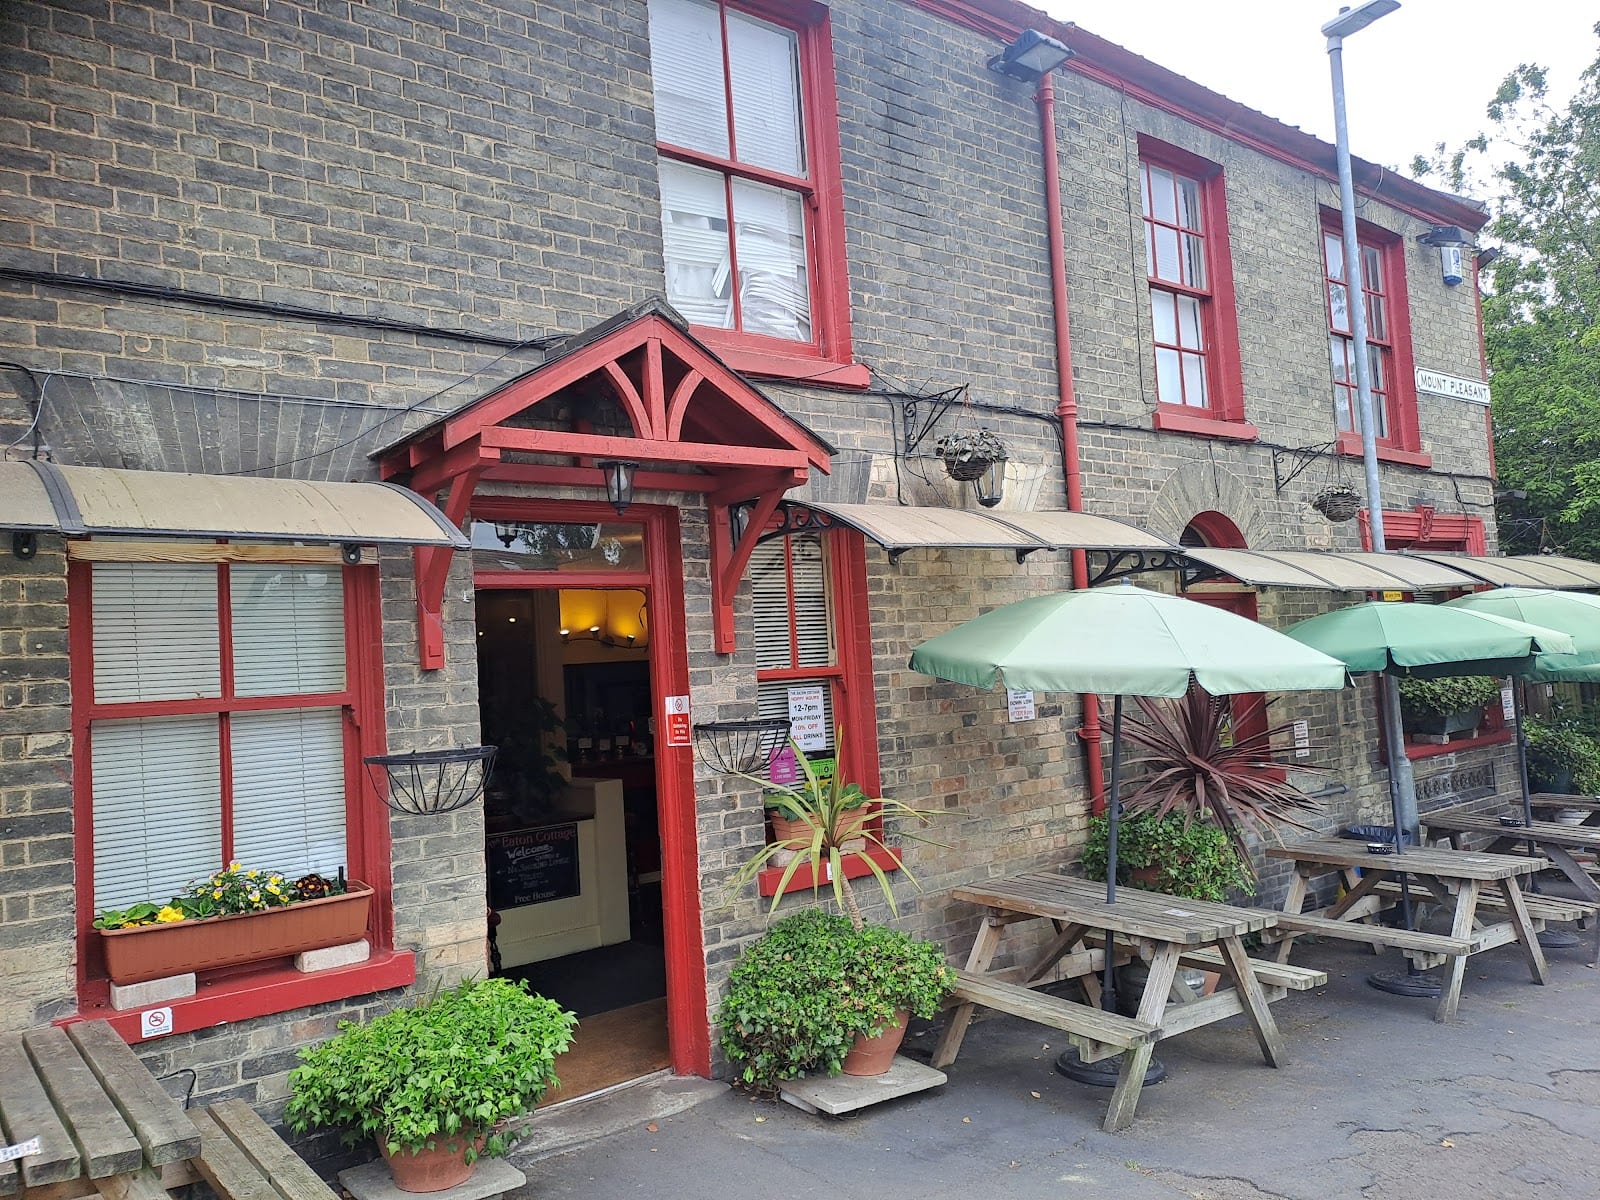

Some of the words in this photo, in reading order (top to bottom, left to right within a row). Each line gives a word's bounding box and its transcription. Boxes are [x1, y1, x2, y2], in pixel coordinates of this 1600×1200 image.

[1420, 373, 1446, 391] MOUNT
[793, 703, 818, 712] 12-7pm
[791, 714, 821, 722] MON-FRIDAY
[502, 835, 533, 847] Eaton
[535, 829, 576, 841] Cottage
[506, 844, 553, 859] Welcome
[515, 895, 531, 903] Free
